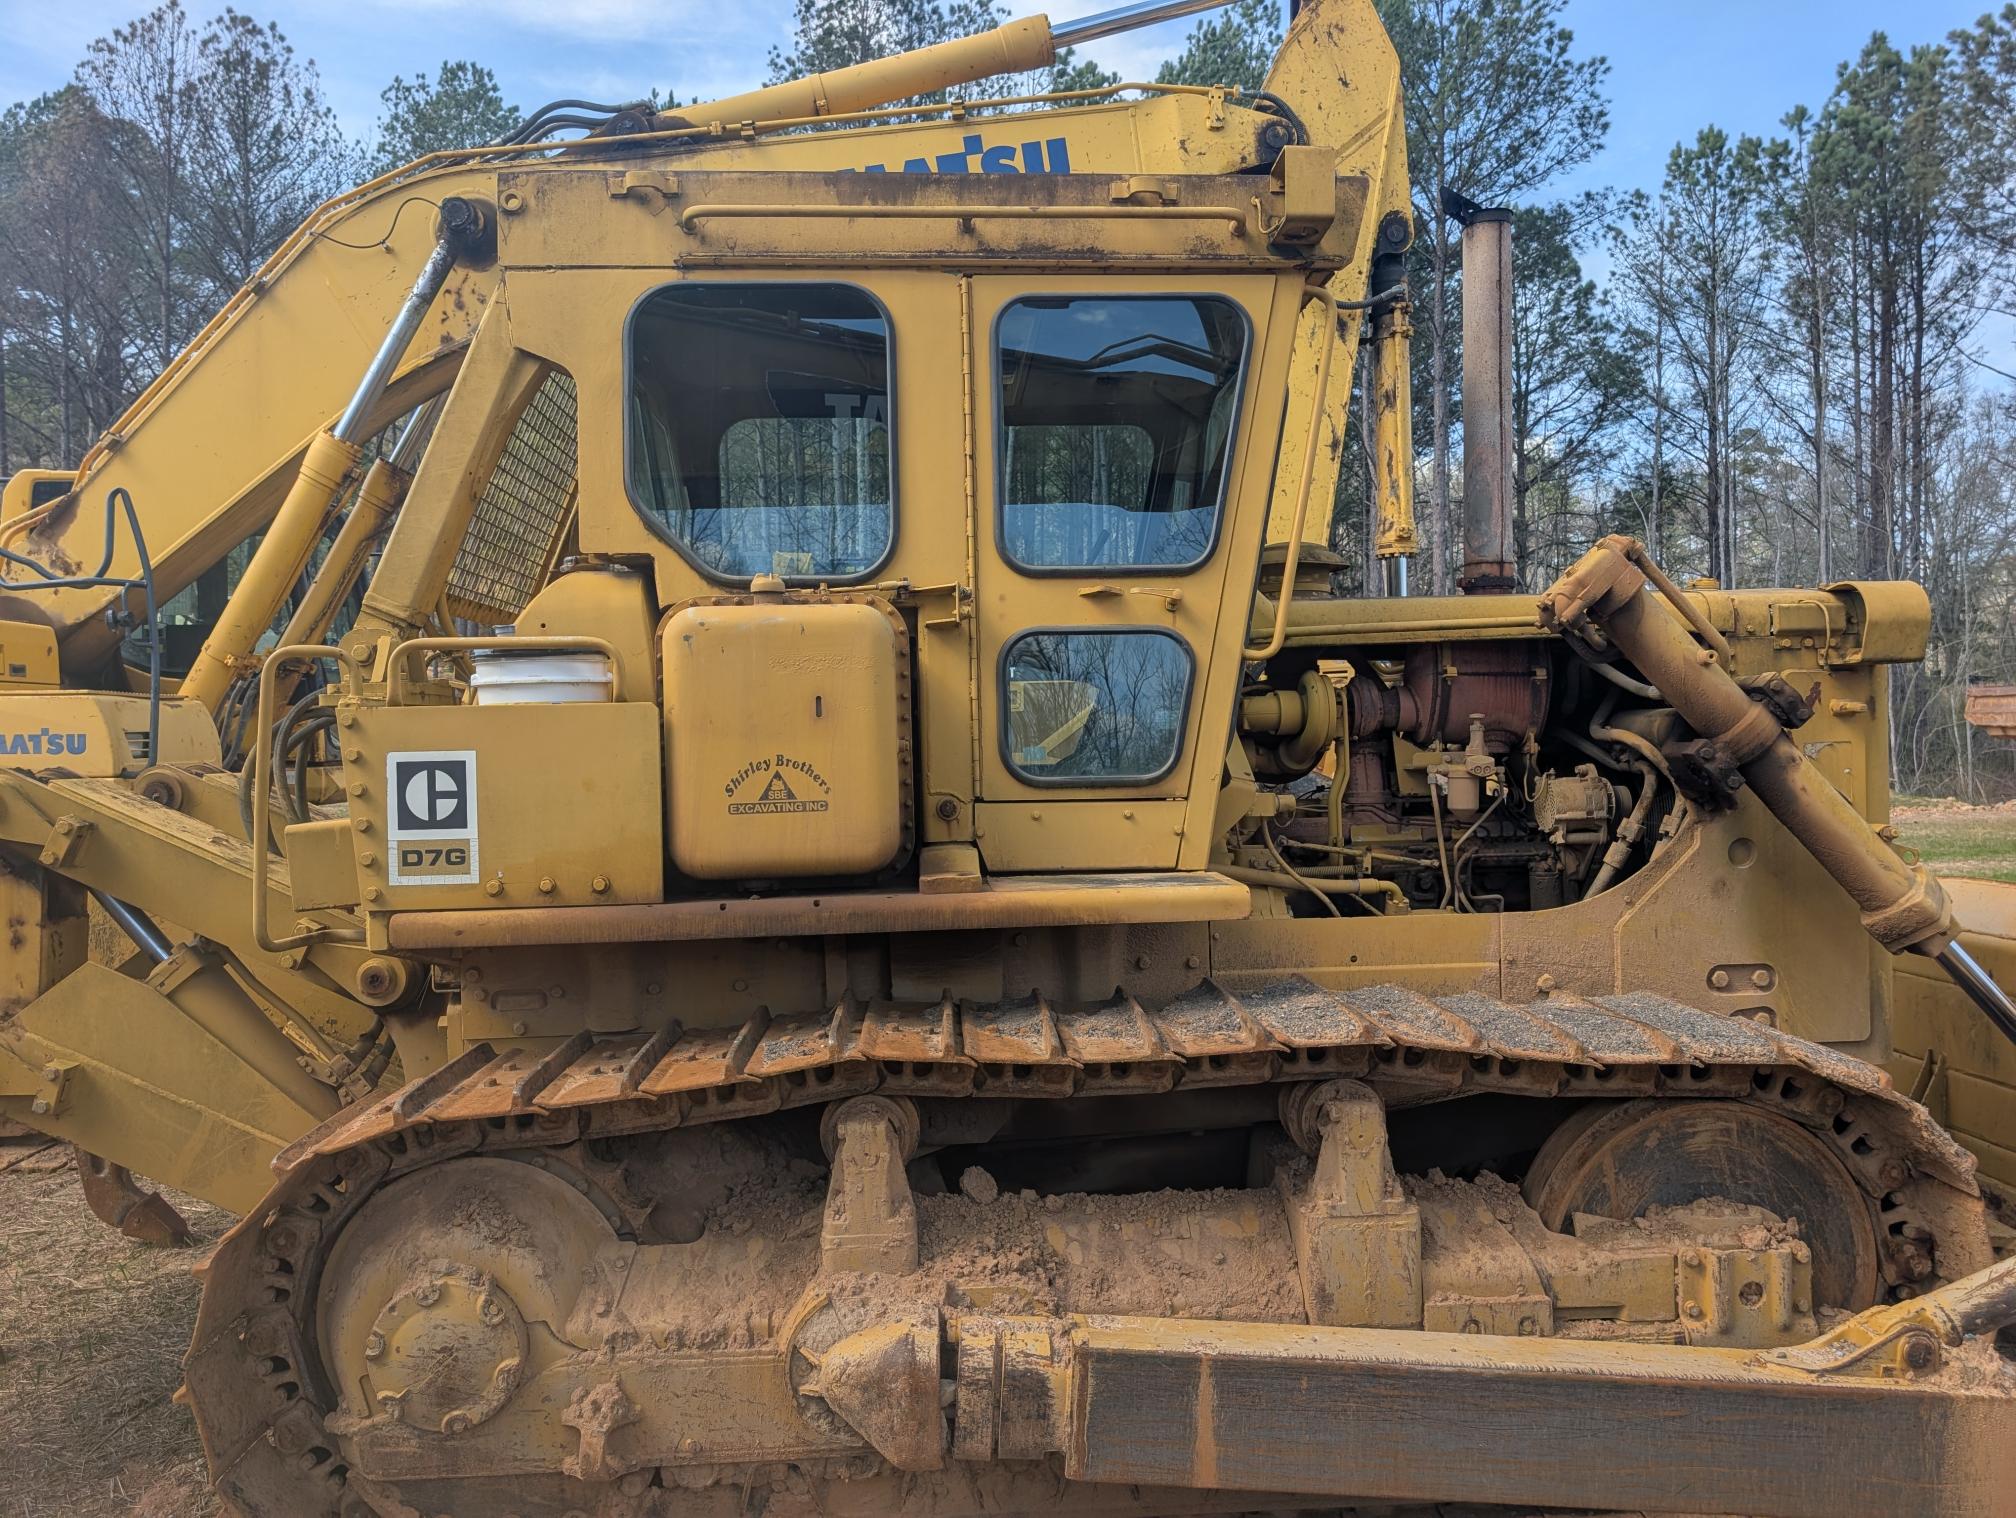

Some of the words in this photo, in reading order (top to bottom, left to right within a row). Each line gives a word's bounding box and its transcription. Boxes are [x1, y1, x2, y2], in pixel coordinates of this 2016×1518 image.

[724, 758, 771, 798] Shirley
[775, 754, 832, 795] Brothers
[768, 790, 788, 800] SBE
[730, 802, 803, 814] EXCAVATING
[805, 801, 826, 811] INC
[402, 848, 466, 867] D7G
